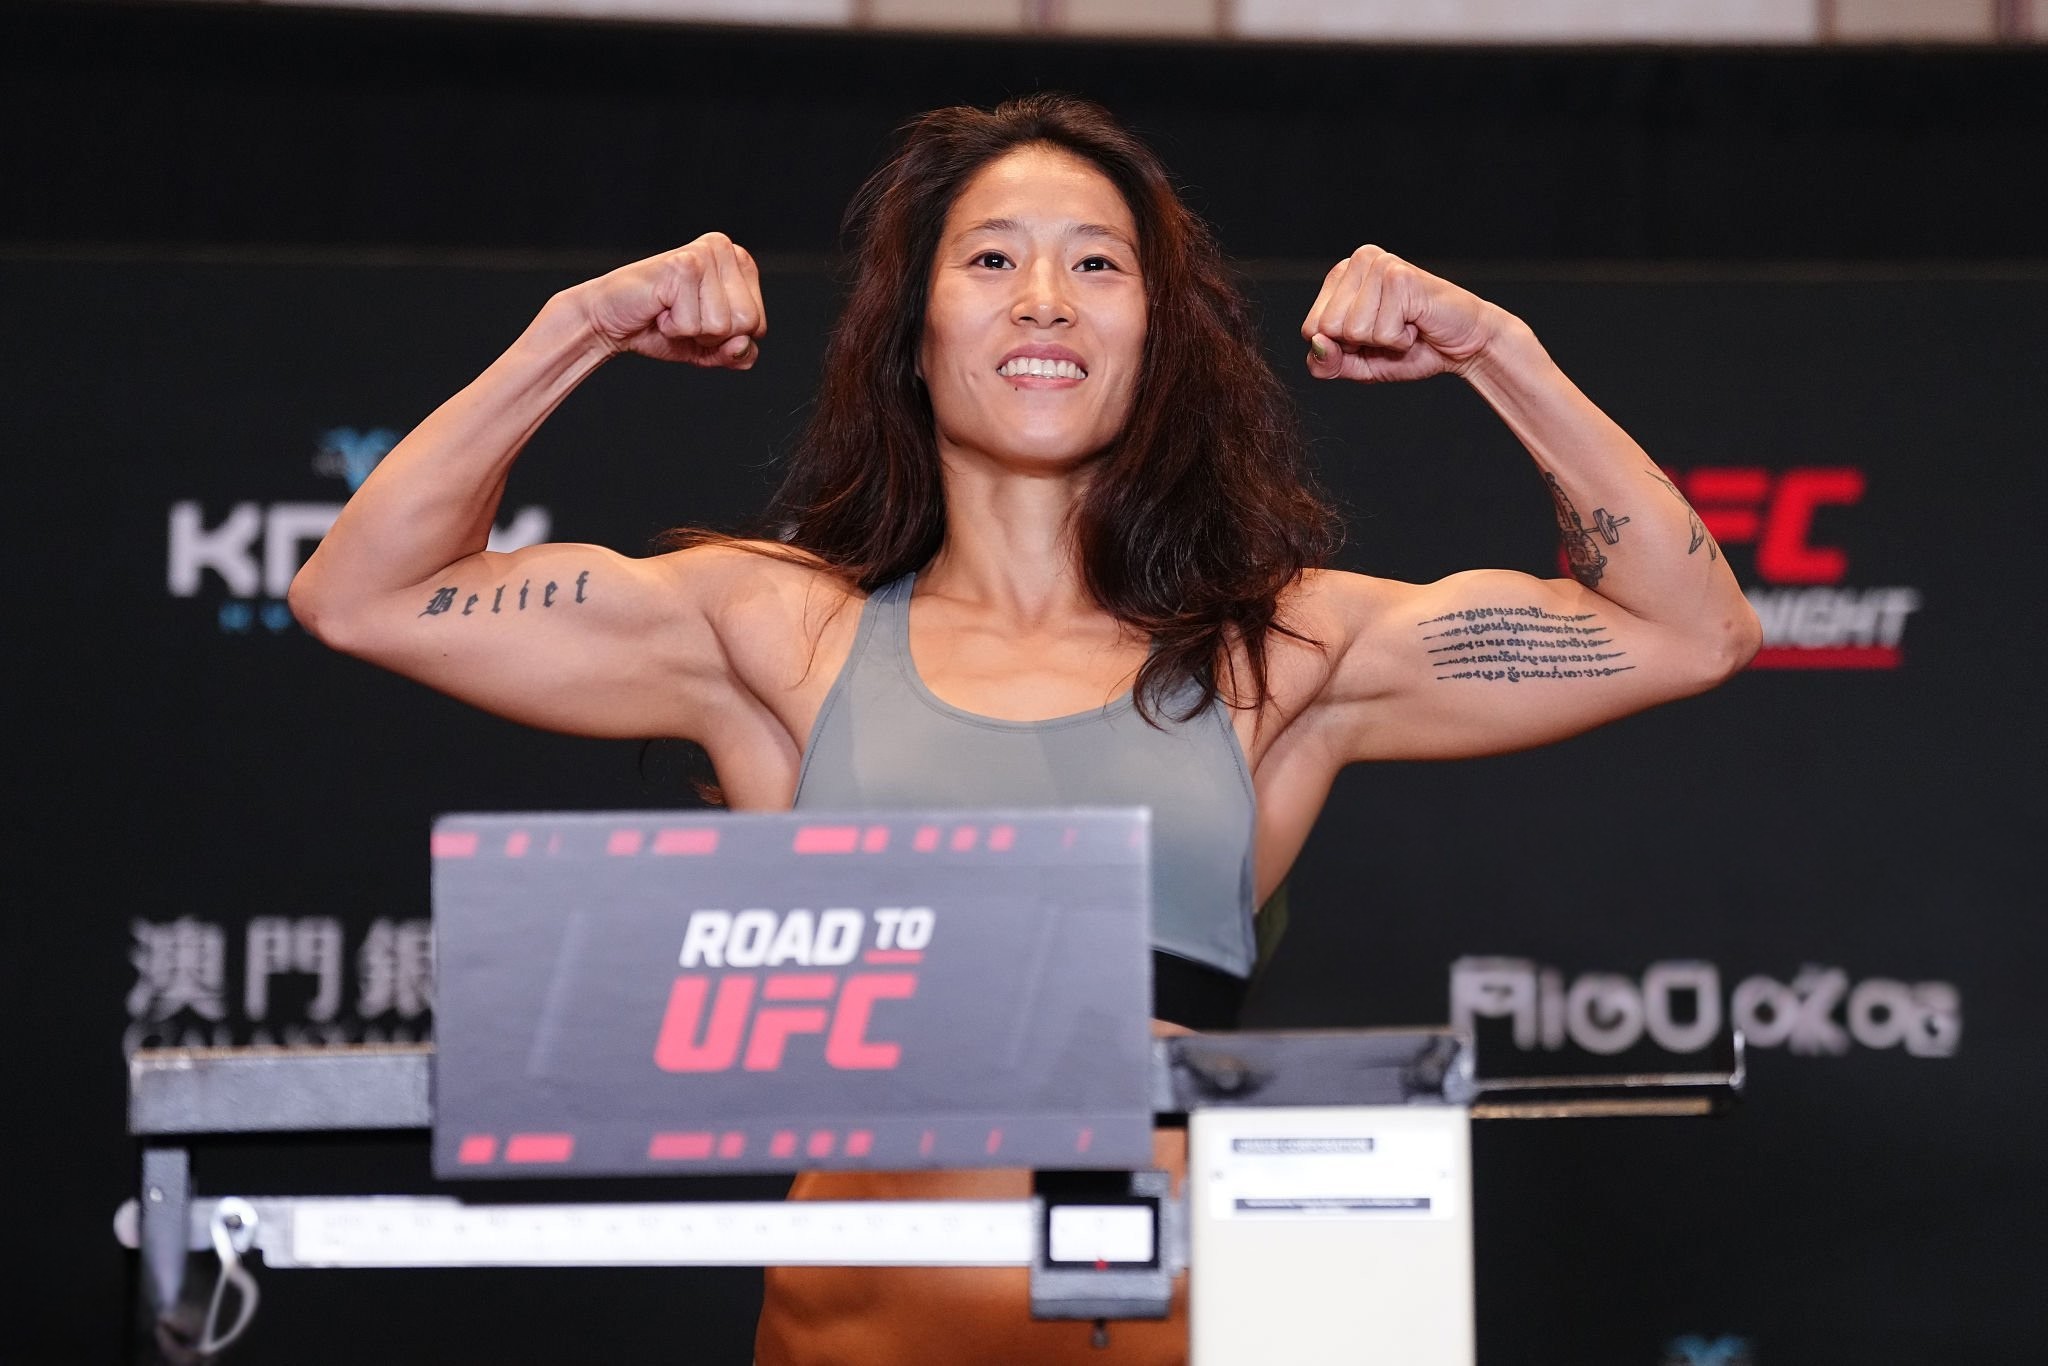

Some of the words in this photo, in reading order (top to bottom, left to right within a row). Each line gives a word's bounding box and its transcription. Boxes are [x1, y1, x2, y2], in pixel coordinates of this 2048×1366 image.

[417, 569, 590, 618] Belief
[679, 908, 865, 967] ROAD
[873, 907, 936, 950] TO
[654, 973, 918, 1073] UFC
